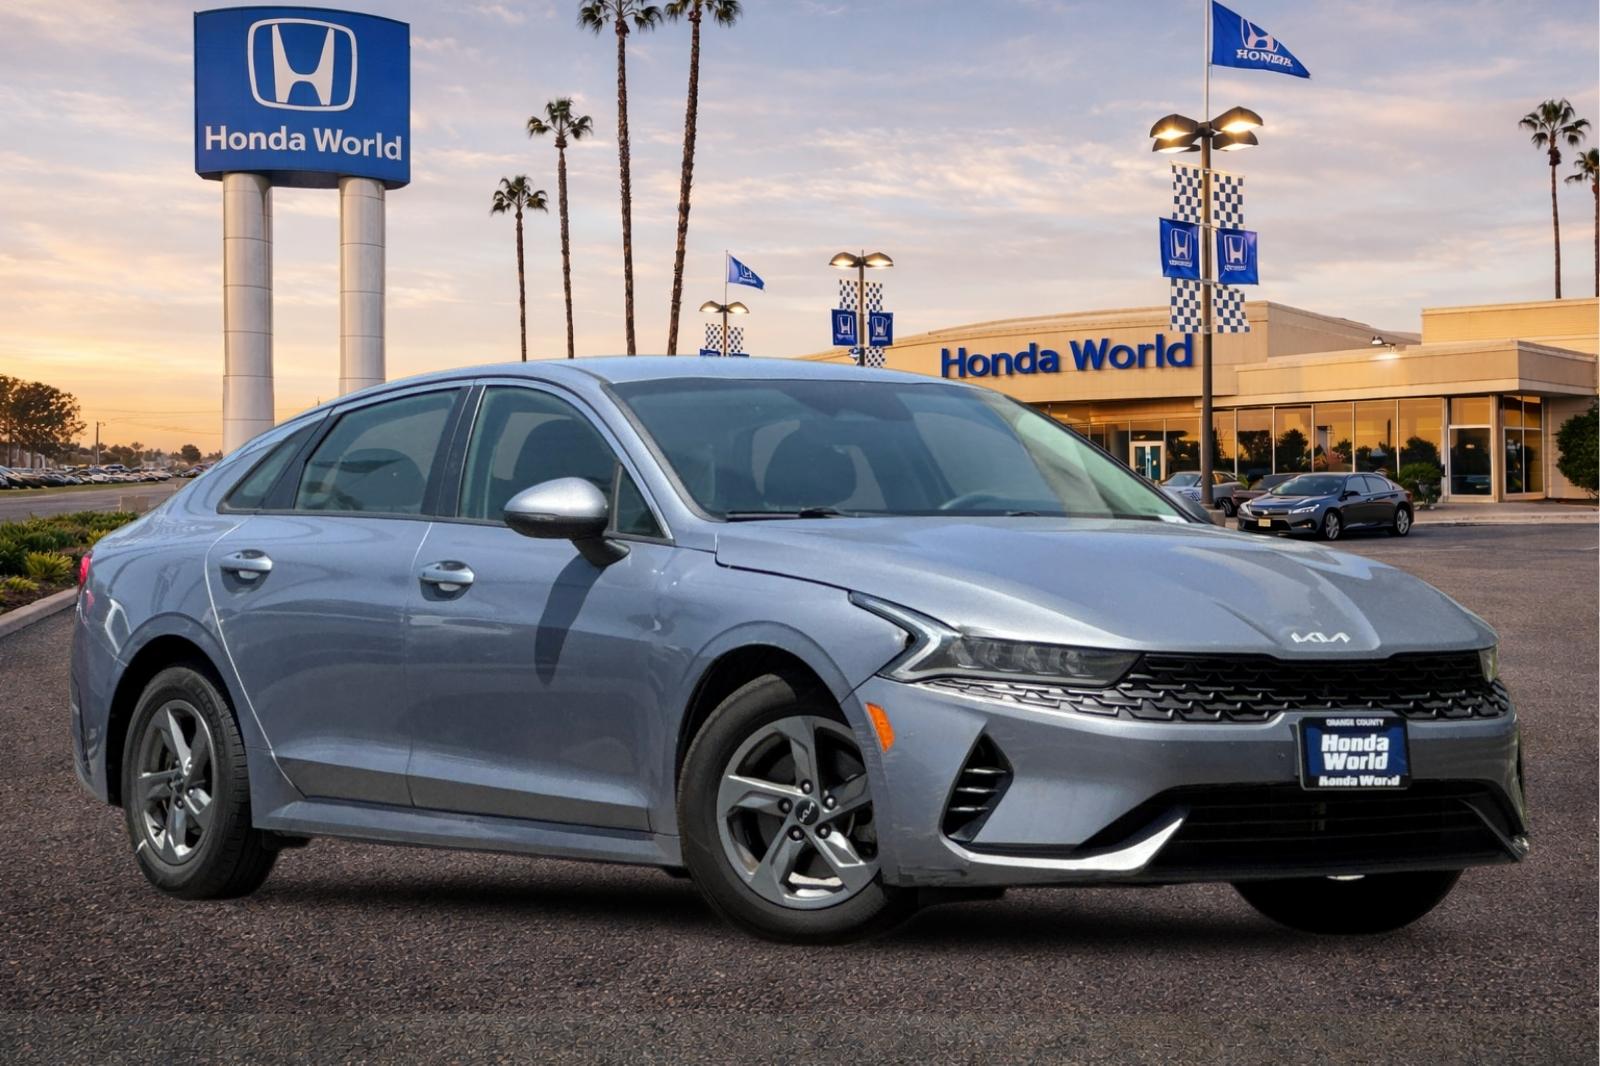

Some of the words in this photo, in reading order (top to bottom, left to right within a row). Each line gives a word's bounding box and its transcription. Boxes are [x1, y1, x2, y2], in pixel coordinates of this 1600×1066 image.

[205, 125, 306, 151] Honda
[313, 127, 402, 161] World
[941, 342, 1062, 378] Honda
[1069, 333, 1195, 371] World
[1291, 632, 1350, 643] KIA
[1356, 718, 1384, 727] COUNTY
[1321, 734, 1390, 752] Honda
[1323, 752, 1389, 770] World
